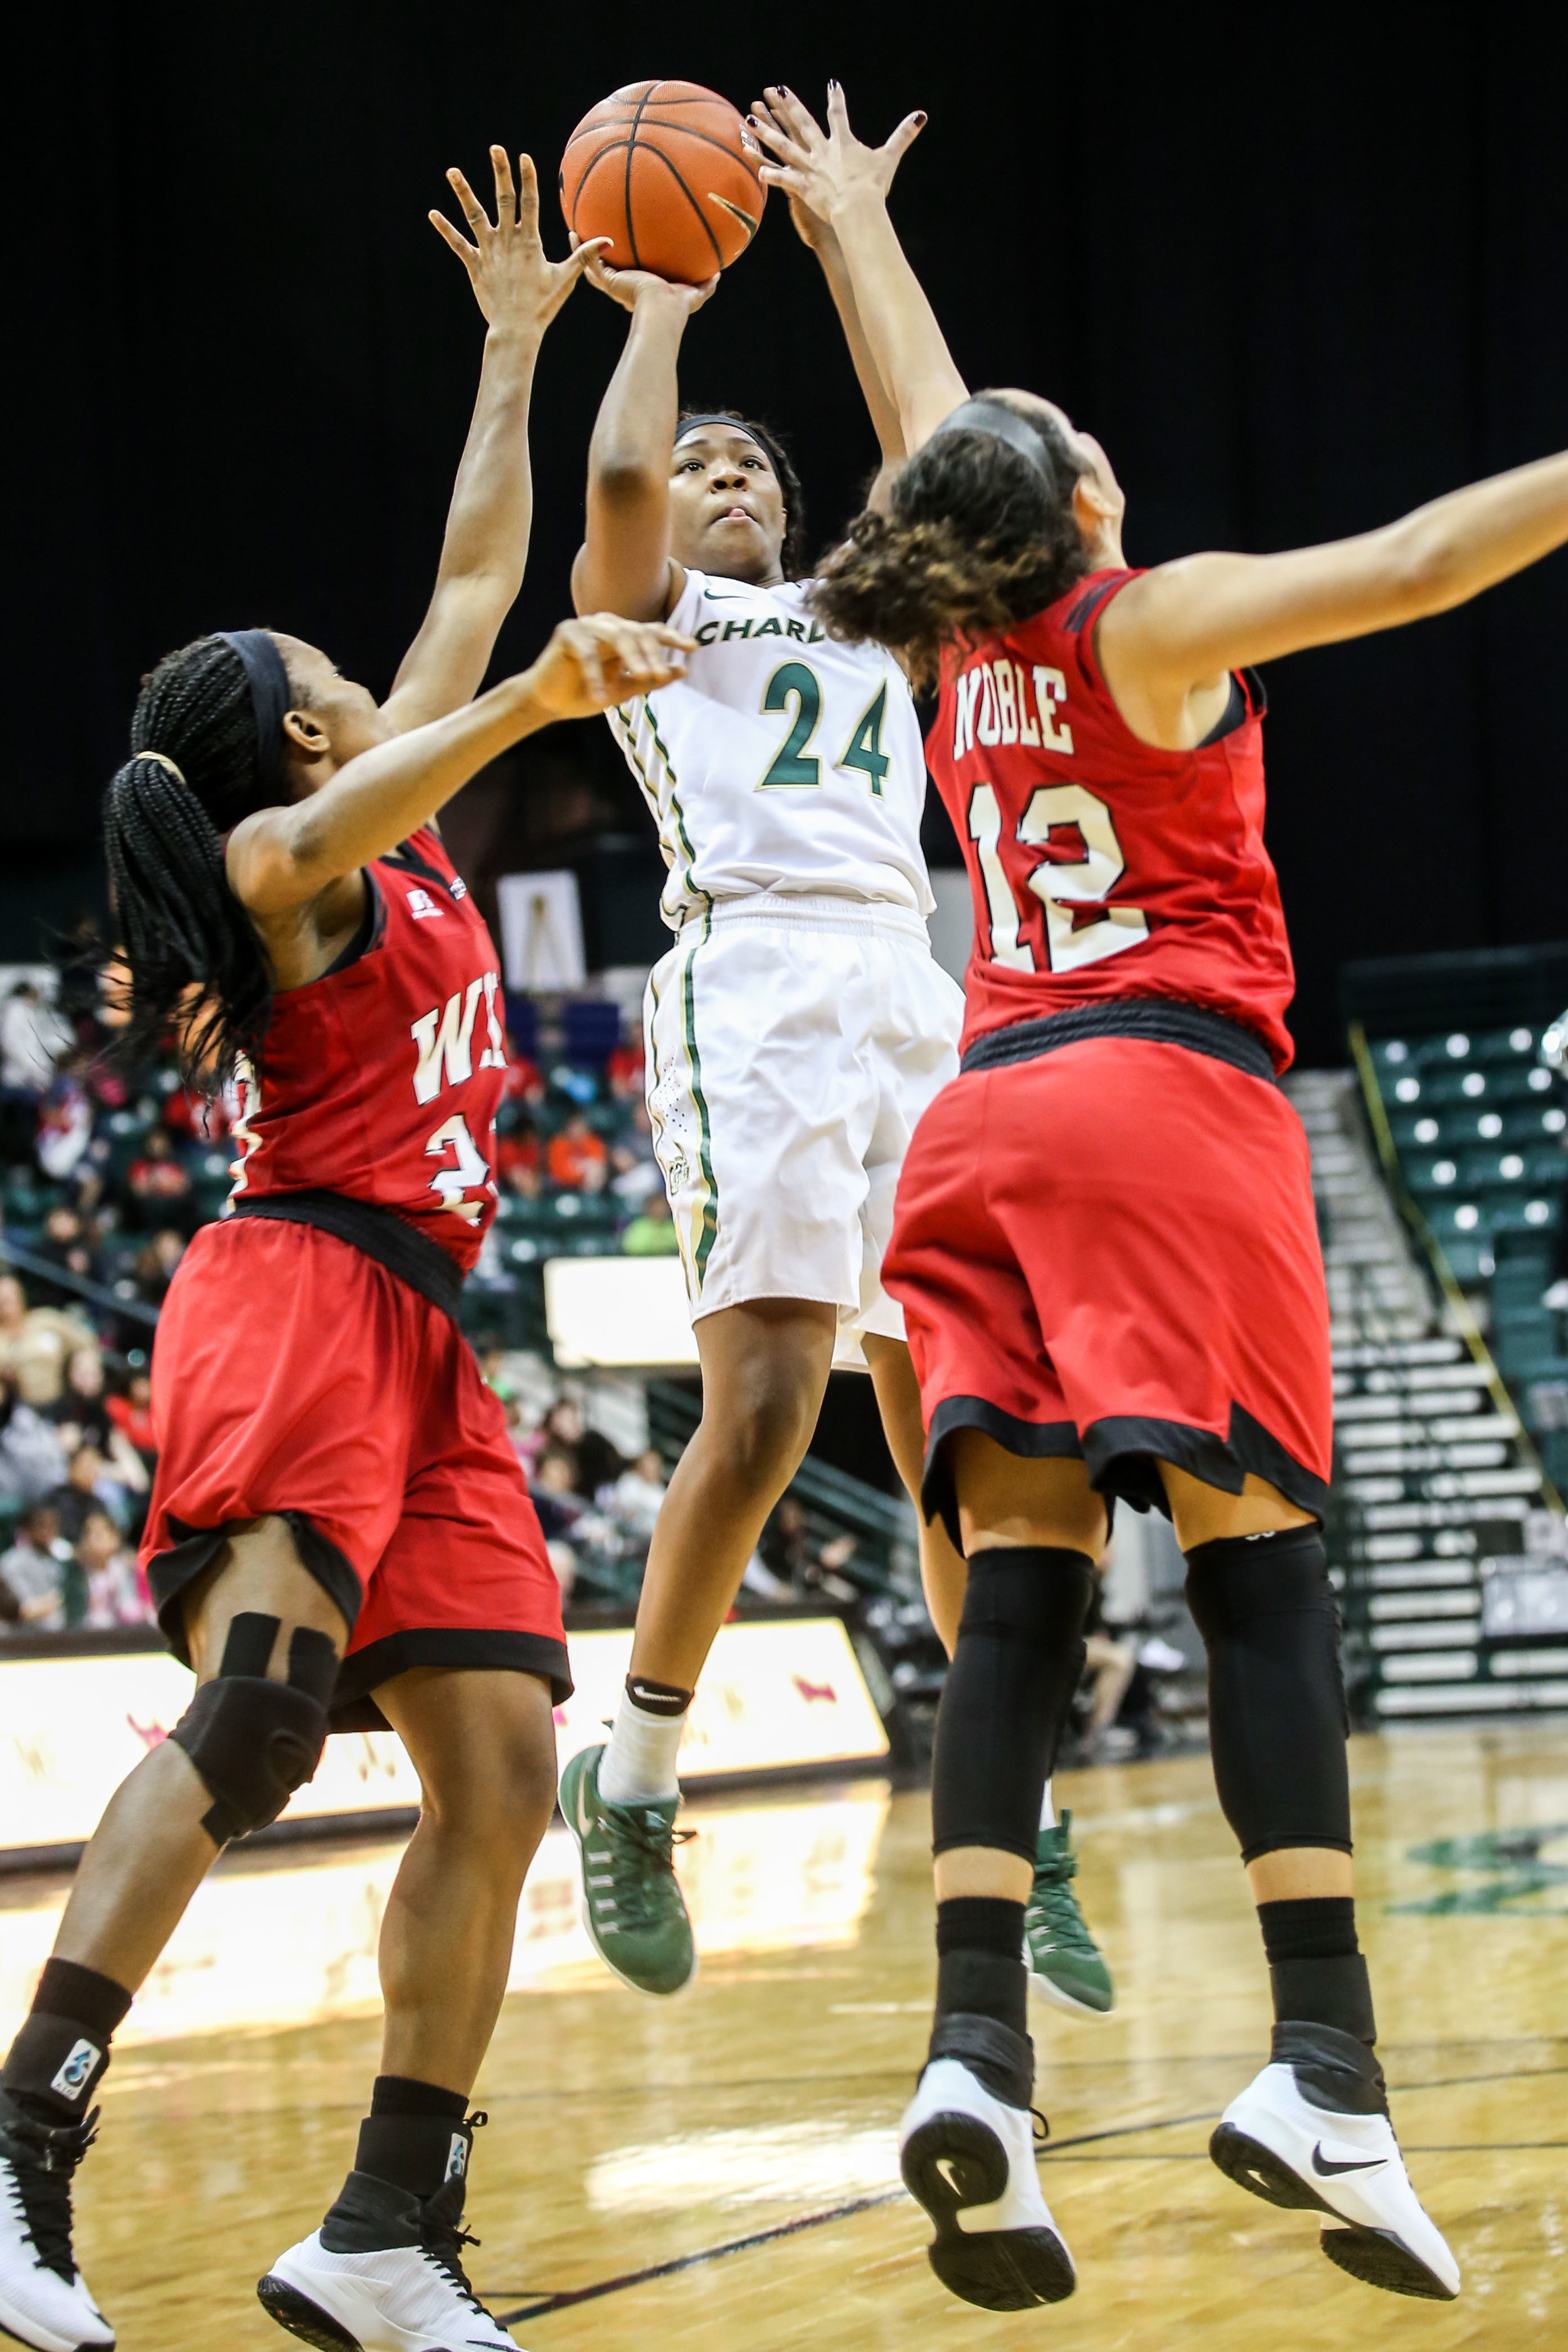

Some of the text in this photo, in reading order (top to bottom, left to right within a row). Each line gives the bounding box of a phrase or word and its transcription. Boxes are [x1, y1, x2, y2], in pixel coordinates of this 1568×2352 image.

[694, 617, 827, 647] CHARL
[753, 659, 891, 801] 24
[953, 659, 1074, 761] NOBLE
[968, 781, 1152, 974] 12
[425, 1113, 499, 1227] 2
